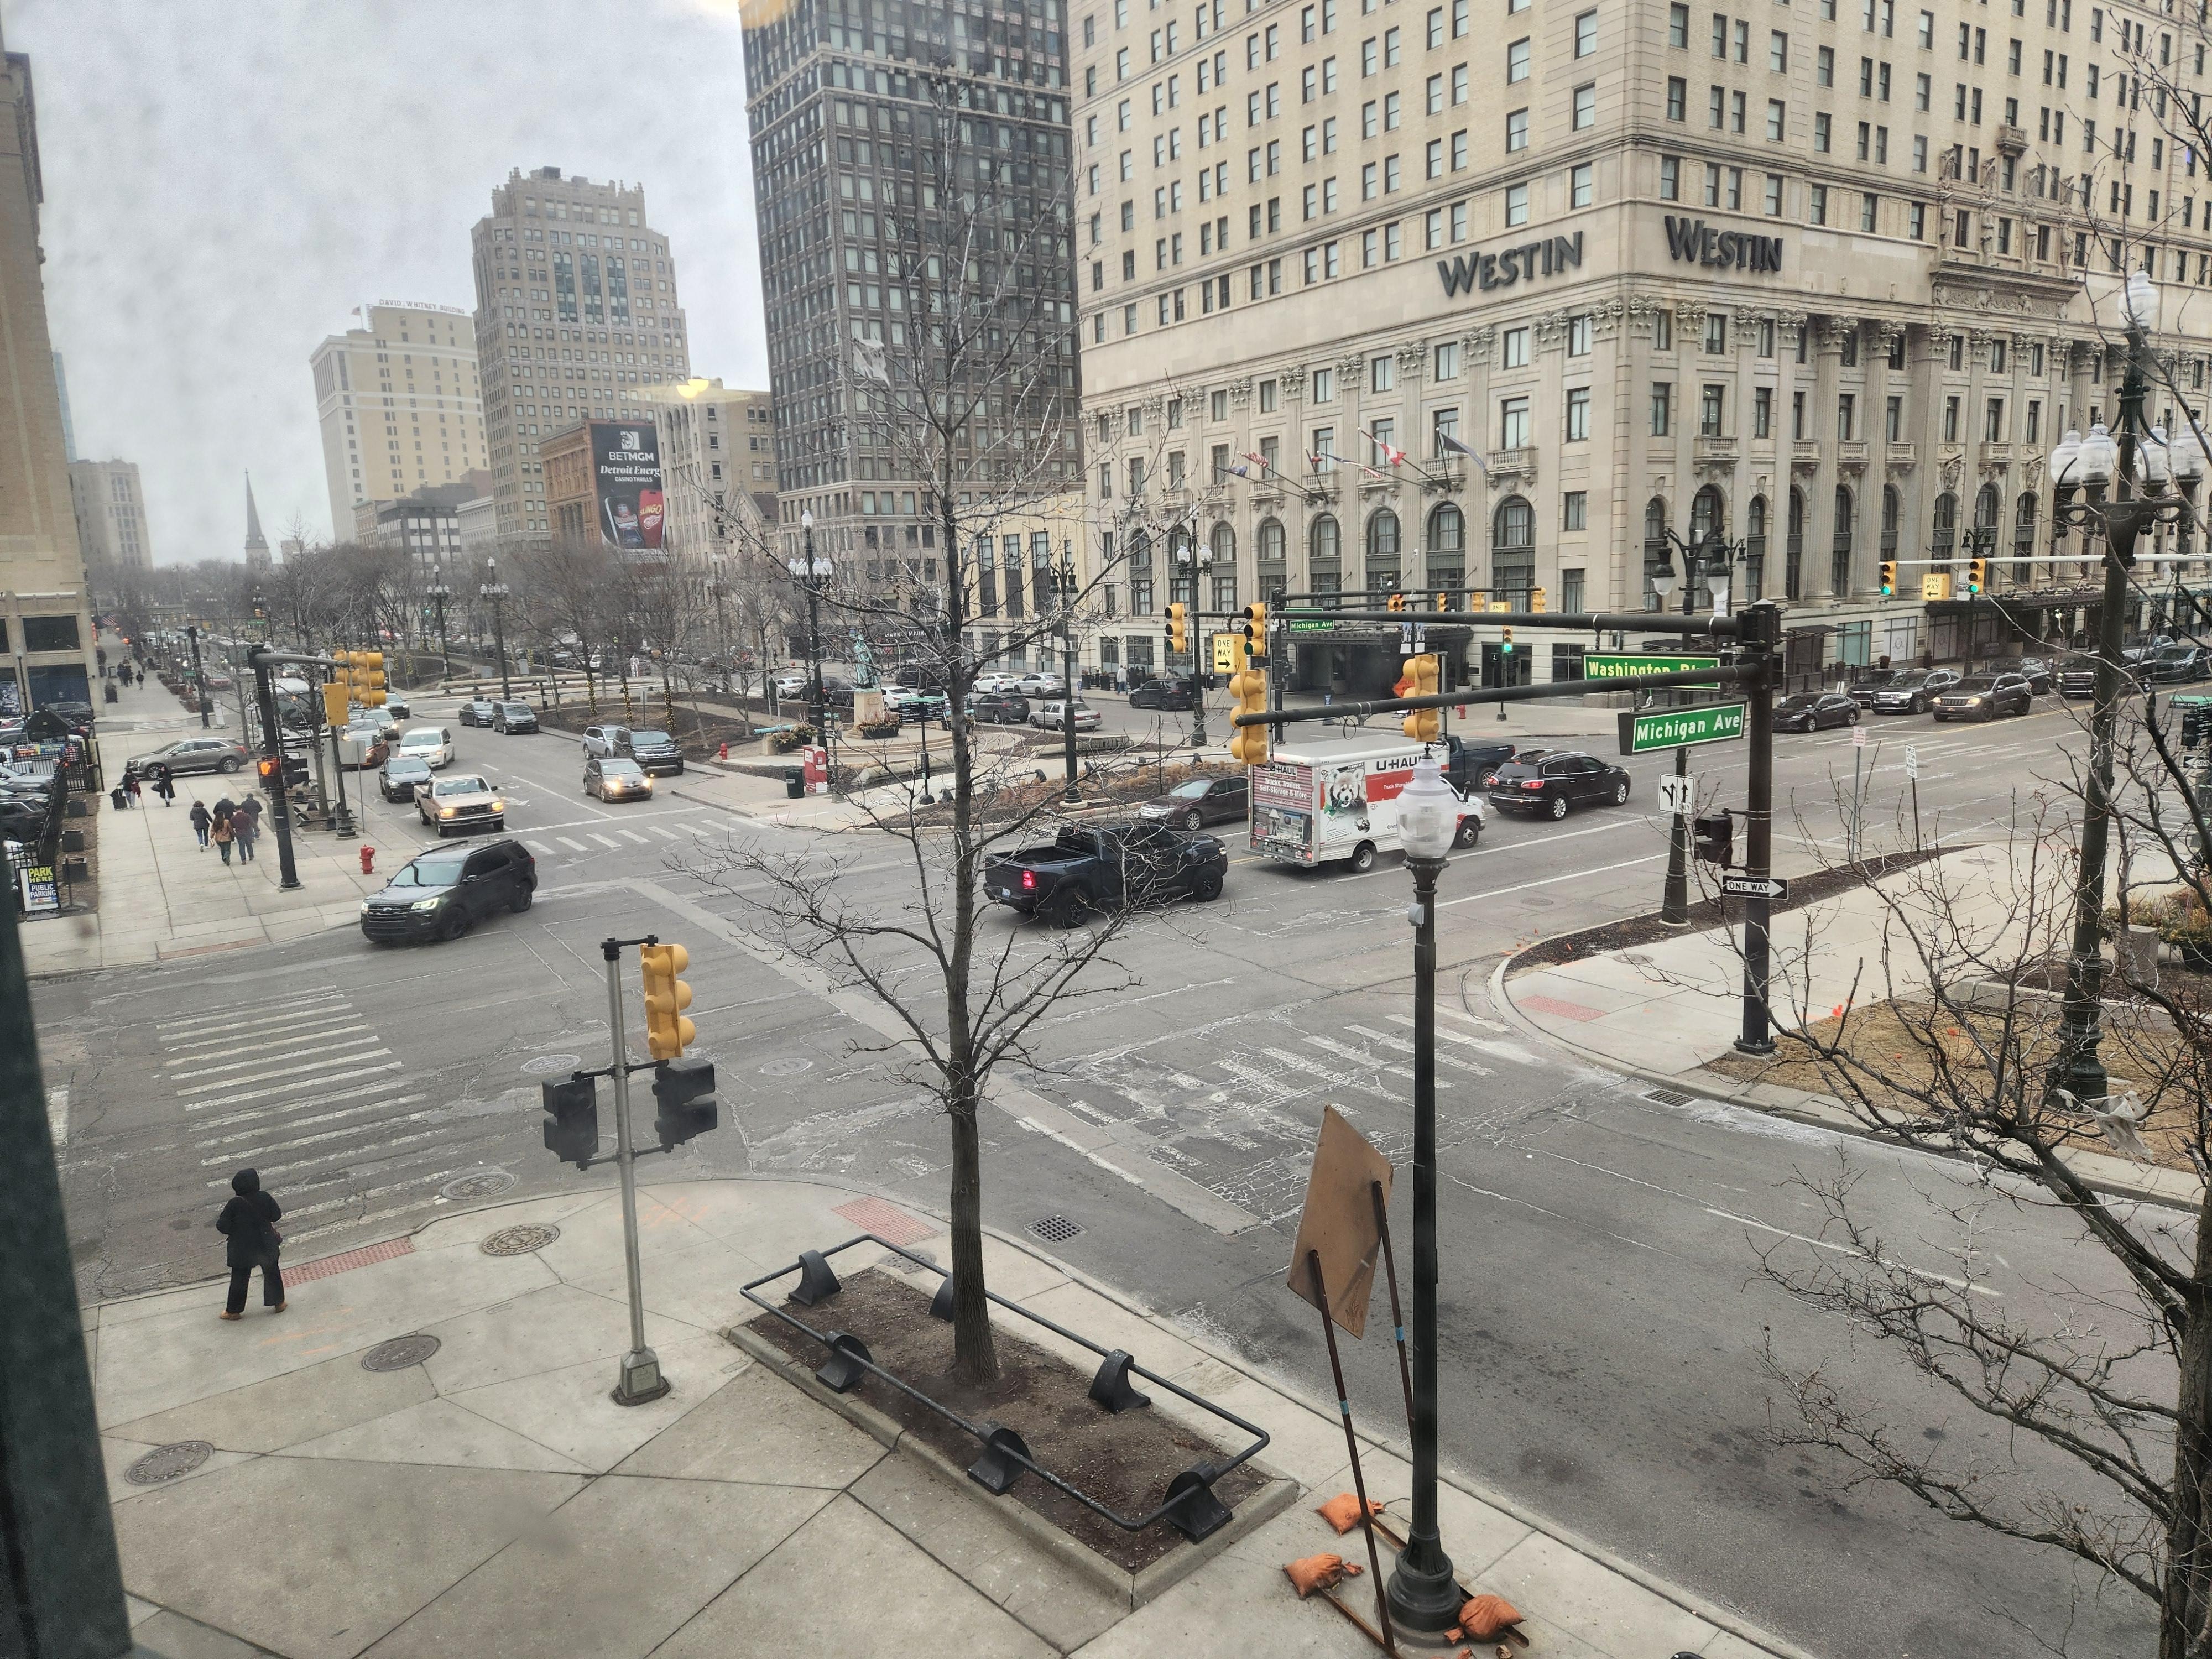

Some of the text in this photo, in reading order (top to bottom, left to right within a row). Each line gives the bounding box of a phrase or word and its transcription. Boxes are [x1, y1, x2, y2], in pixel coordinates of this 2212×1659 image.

[1664, 215, 1783, 272] WESTIN
[1436, 231, 1582, 297] WESTIN
[406, 301, 437, 309] WHITNEY
[440, 305, 465, 314] BUILDING
[609, 452, 654, 461] BETMGM
[600, 465, 661, 477] Detroit Energ
[1636, 714, 1740, 742] Michigan Ave
[1376, 755, 1421, 771] U-HAU
[1259, 784, 1289, 796] Self-Storage
[1264, 778, 1302, 791] Trucks, Trailers,
[28, 866, 53, 878] PARK
[1729, 881, 1769, 892] ONE WAY
[30, 890, 56, 898] PARKING
